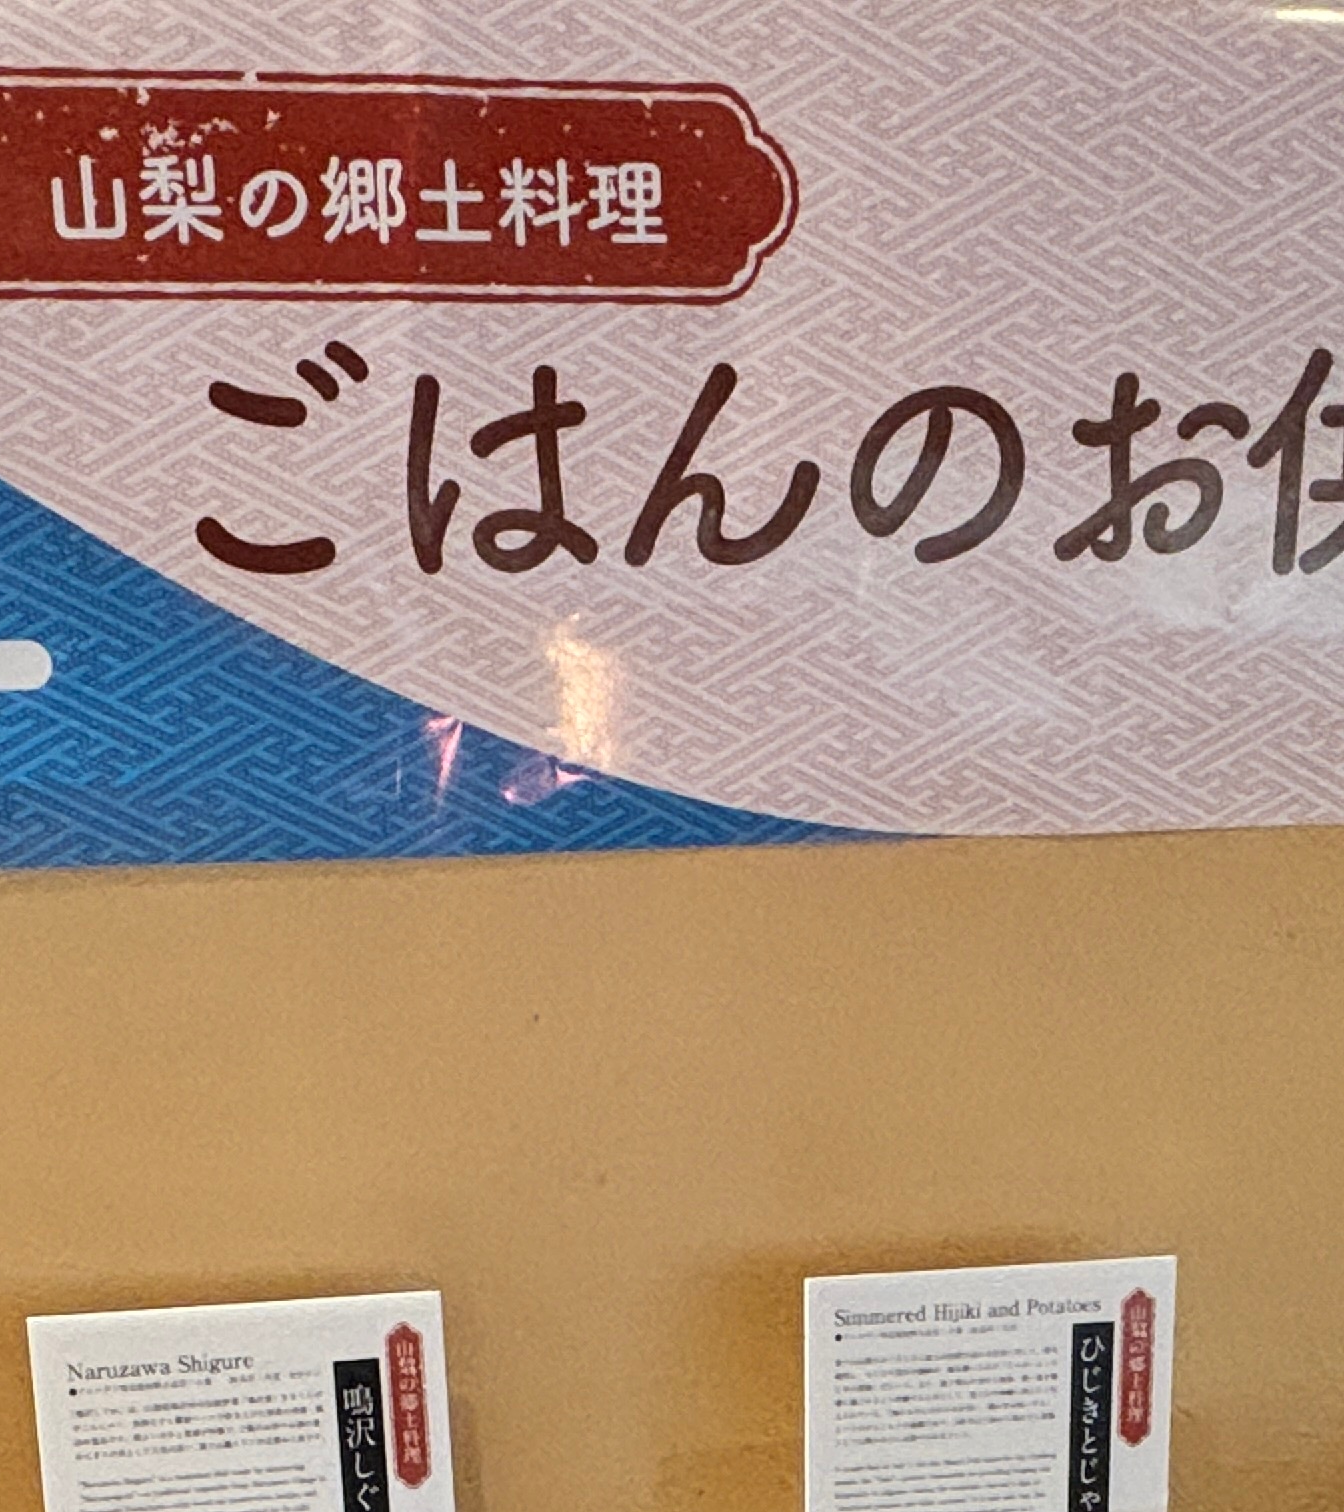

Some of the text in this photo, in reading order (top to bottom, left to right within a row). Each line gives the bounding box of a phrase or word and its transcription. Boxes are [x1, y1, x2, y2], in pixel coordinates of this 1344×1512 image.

[49, 153, 669, 248] 山梨の郷土料理
[834, 1299, 1102, 1327] Simmered Hijiki and Potatoes
[67, 1353, 254, 1381] Naruzawa Shigure
